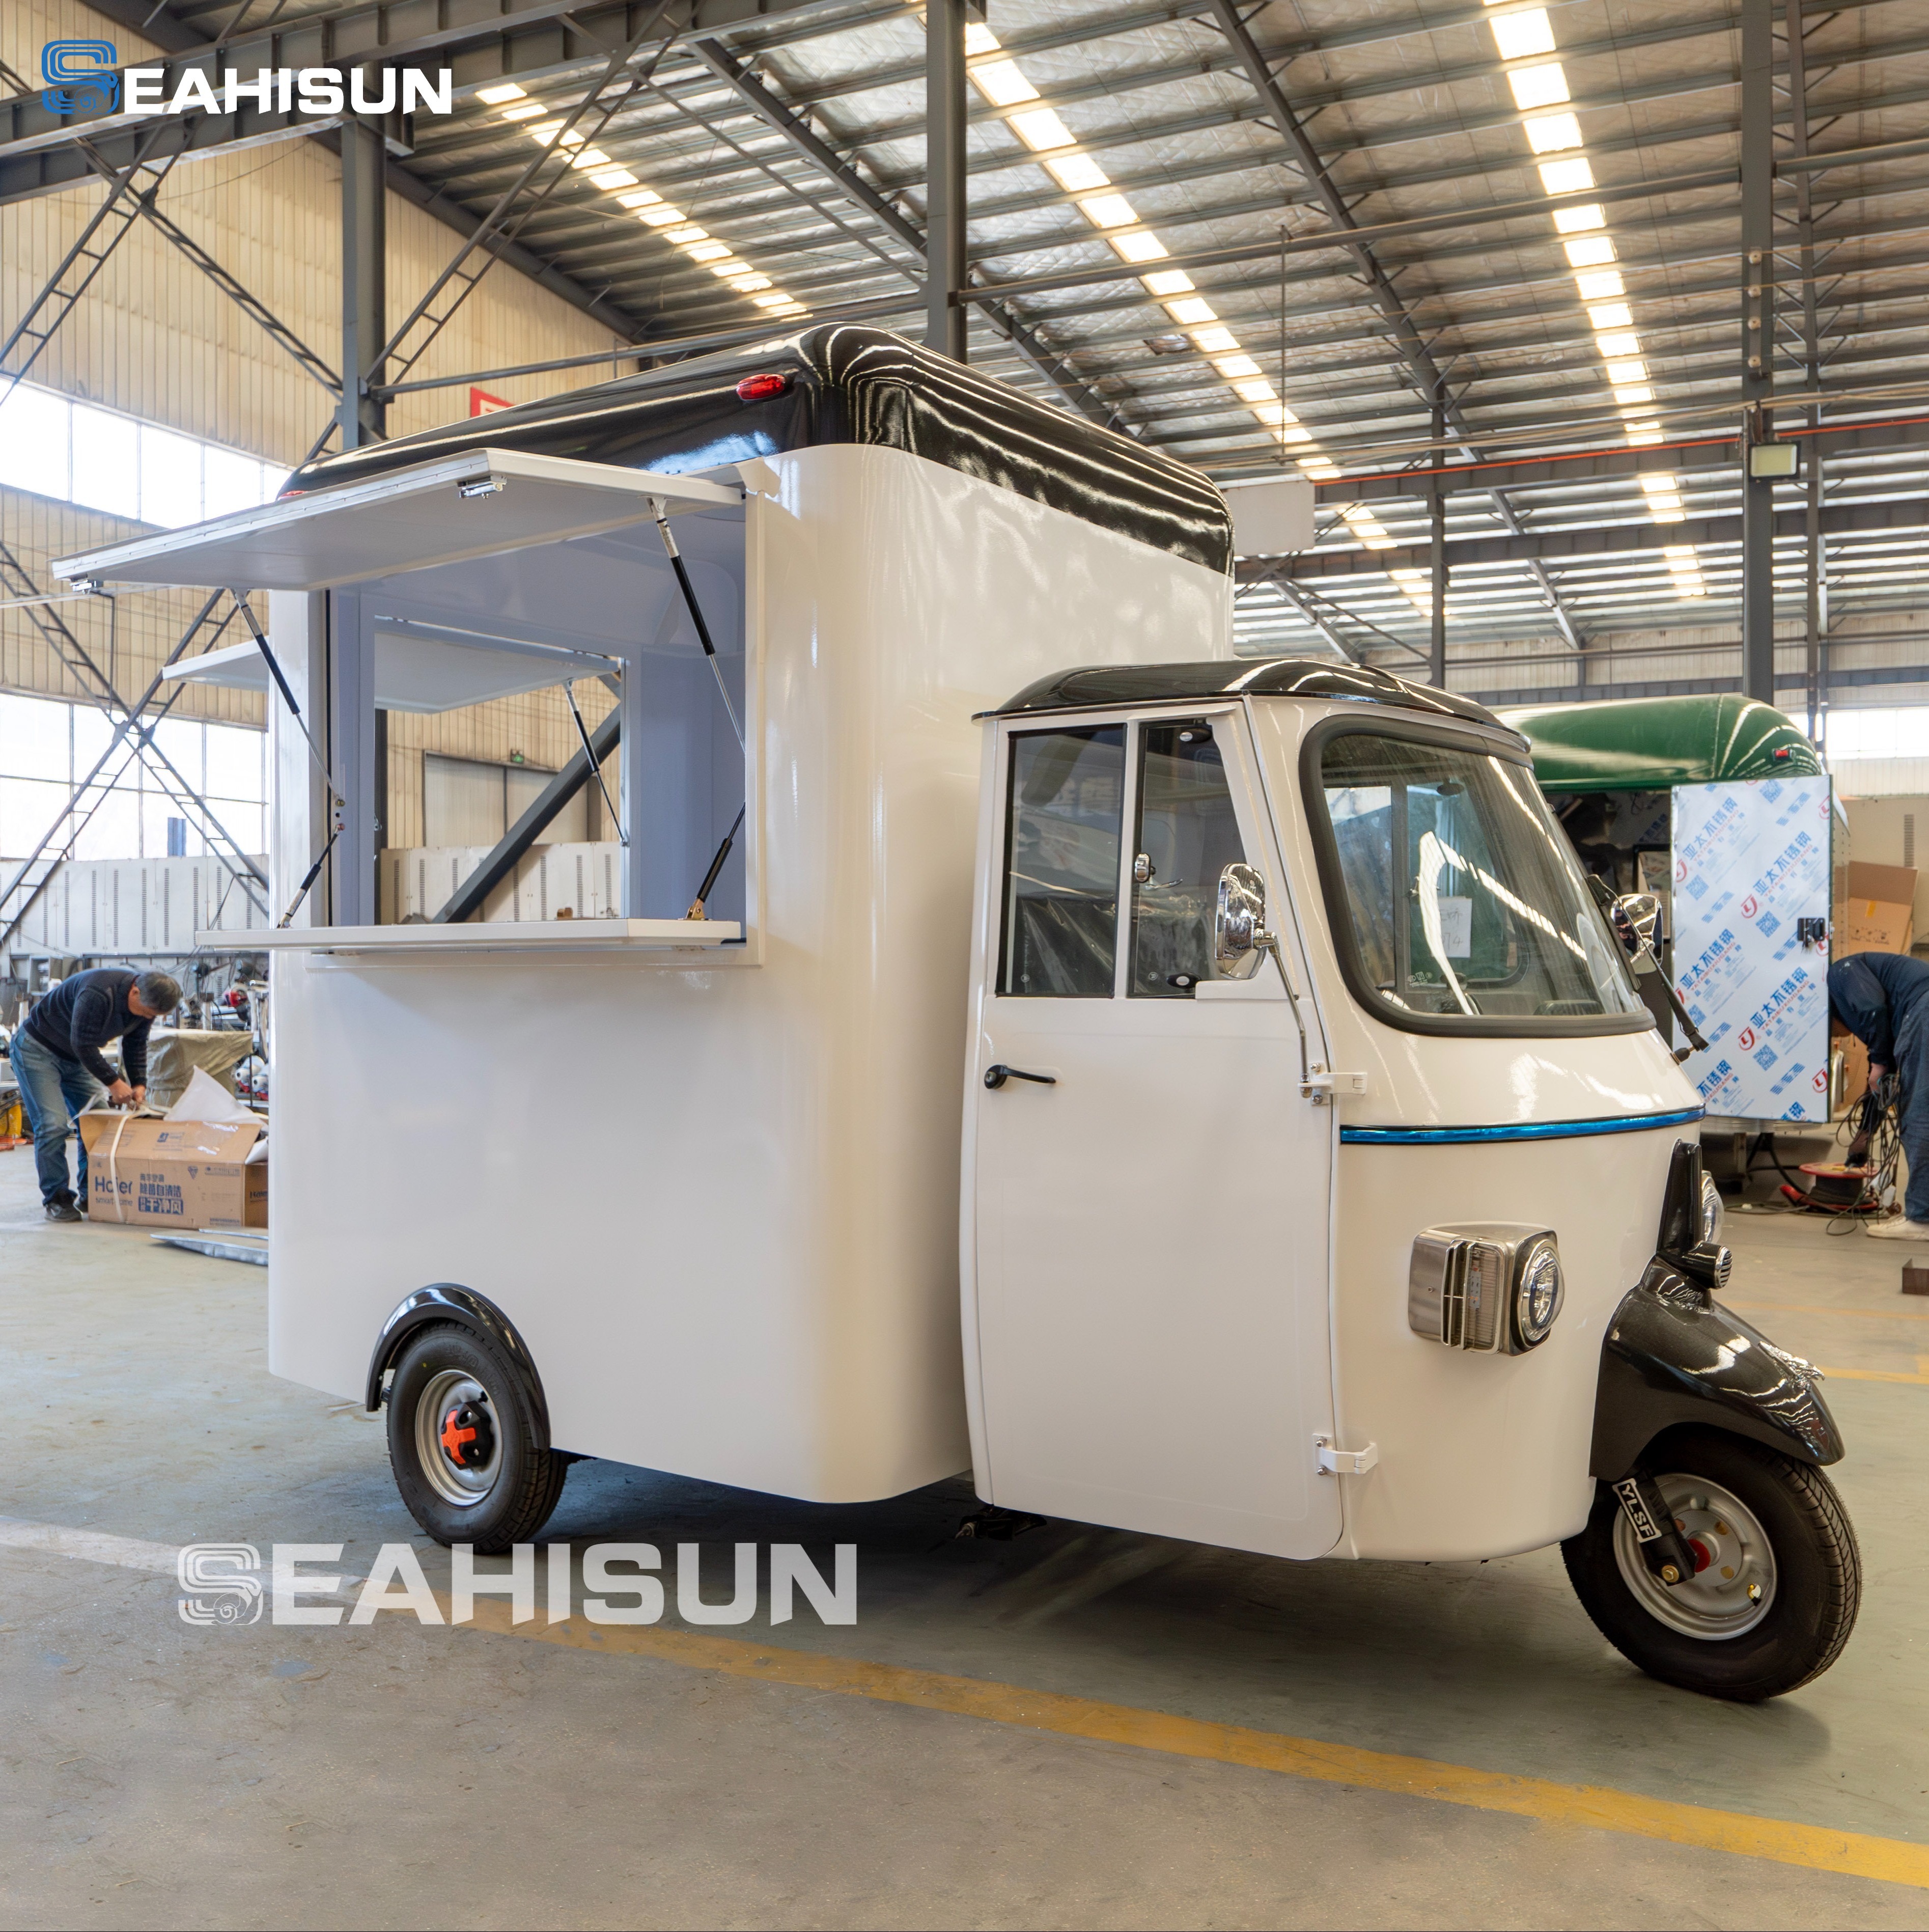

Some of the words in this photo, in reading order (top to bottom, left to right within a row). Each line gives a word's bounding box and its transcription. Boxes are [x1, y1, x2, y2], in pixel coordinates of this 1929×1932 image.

[1683, 797, 1738, 860] 亚太不锈钢
[1753, 831, 1811, 896] 亚太不锈钢
[1680, 929, 1735, 989] 亚太不锈钢
[1750, 967, 1808, 1029] 亚太不锈钢
[1622, 1484, 1654, 1536] YLSF
